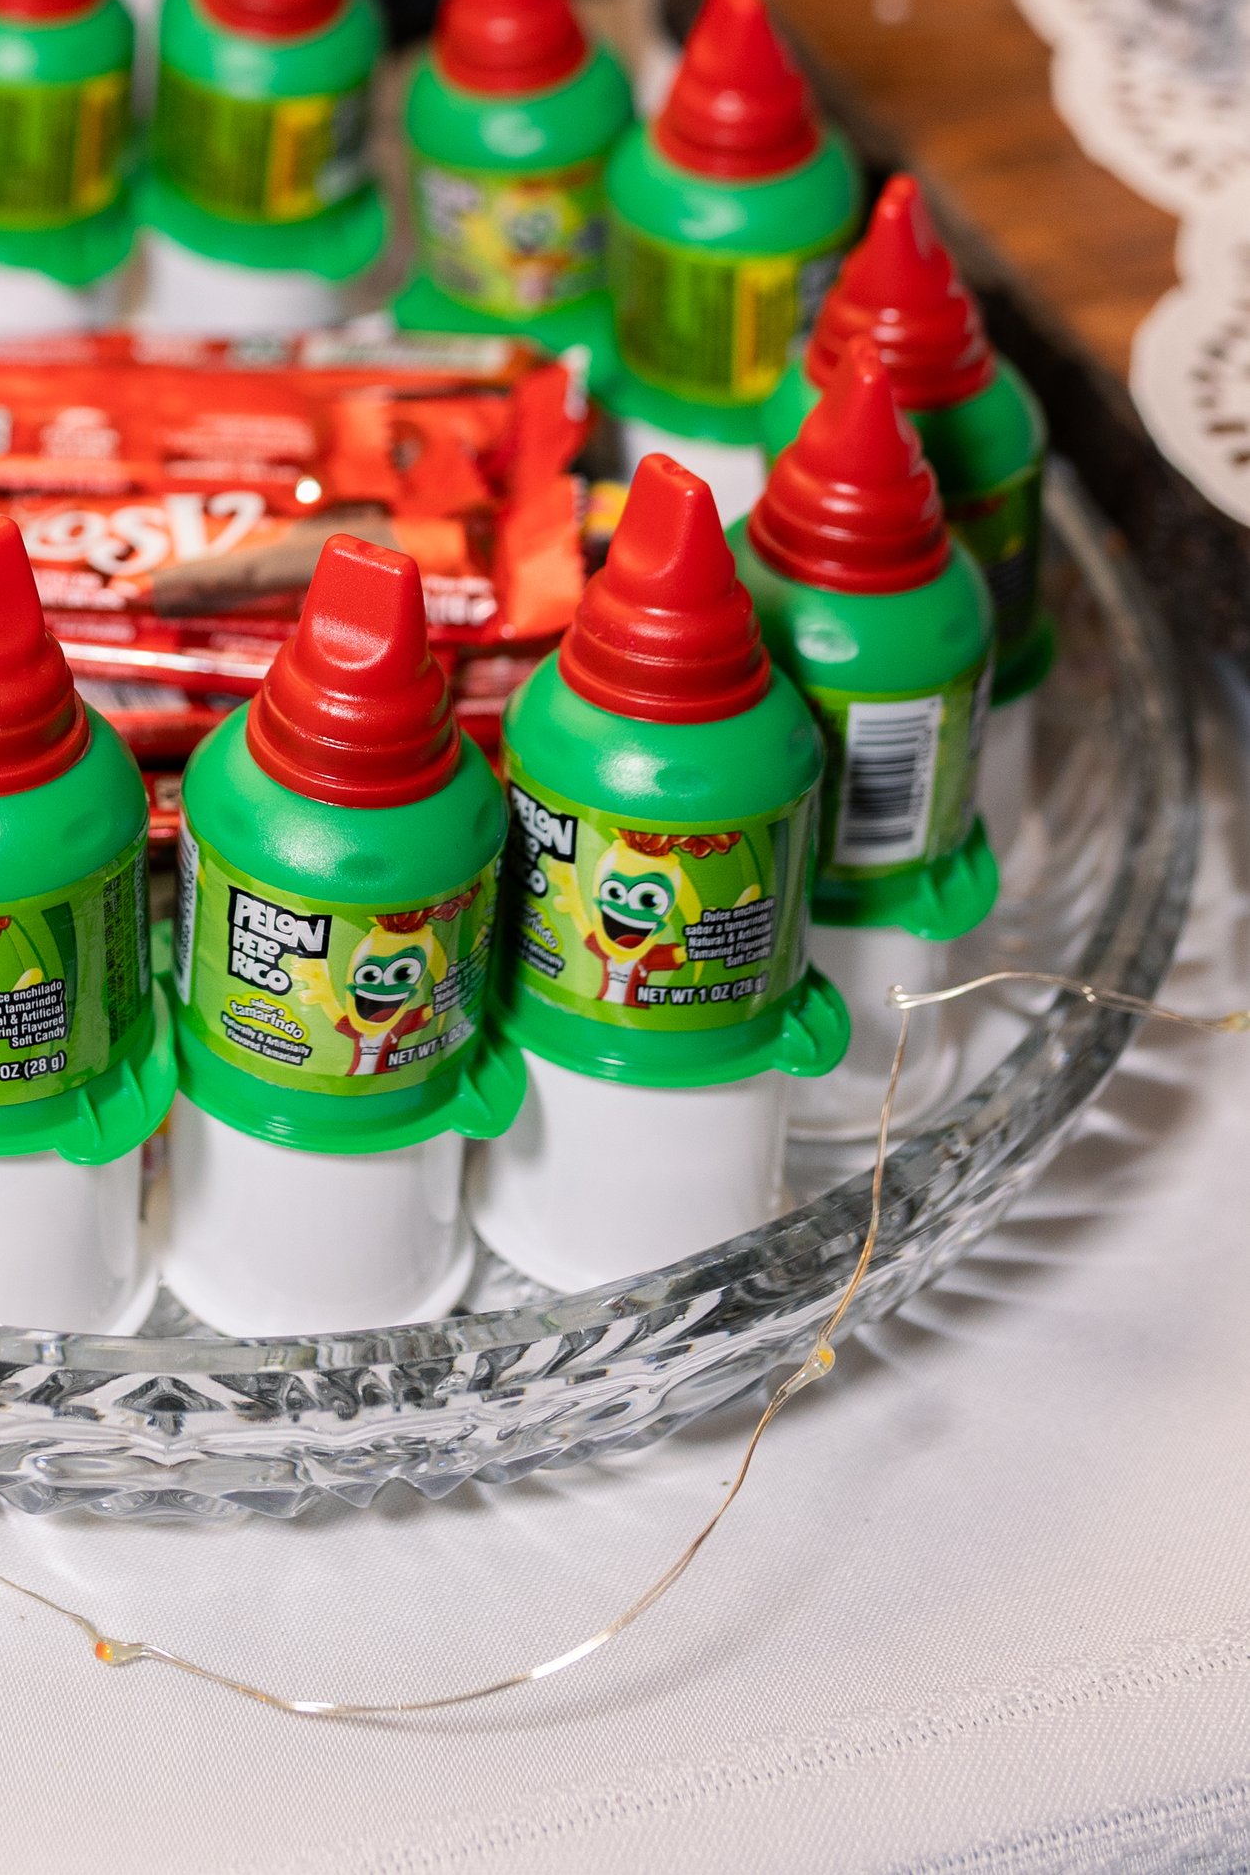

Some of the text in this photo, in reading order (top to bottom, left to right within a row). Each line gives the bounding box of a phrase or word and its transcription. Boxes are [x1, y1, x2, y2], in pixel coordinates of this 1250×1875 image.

[233, 893, 325, 952] PELON
[703, 910, 731, 923] Dulce
[685, 924, 714, 936] sabor
[232, 925, 281, 964] PELO
[688, 935, 725, 947] Natural
[688, 946, 734, 960] Tamarind
[231, 950, 290, 992] RICO
[13, 981, 63, 1001] enchilado
[638, 986, 669, 1003] NET
[671, 988, 695, 1004] WT
[699, 988, 706, 1003] 1
[711, 984, 730, 1001] OZ
[5, 994, 57, 1014] tamarindo
[10, 1013, 18, 1025] &
[21, 1002, 64, 1023] Artificial
[21, 1014, 64, 1034] Flavored
[231, 1001, 304, 1039] tamarindo
[11, 1026, 65, 1047] Soft Candy
[388, 1048, 415, 1066] NET
[418, 1039, 438, 1058] WT
[0, 1063, 20, 1079] OZ
[24, 1057, 47, 1078] (28
[51, 1052, 65, 1071] g)
